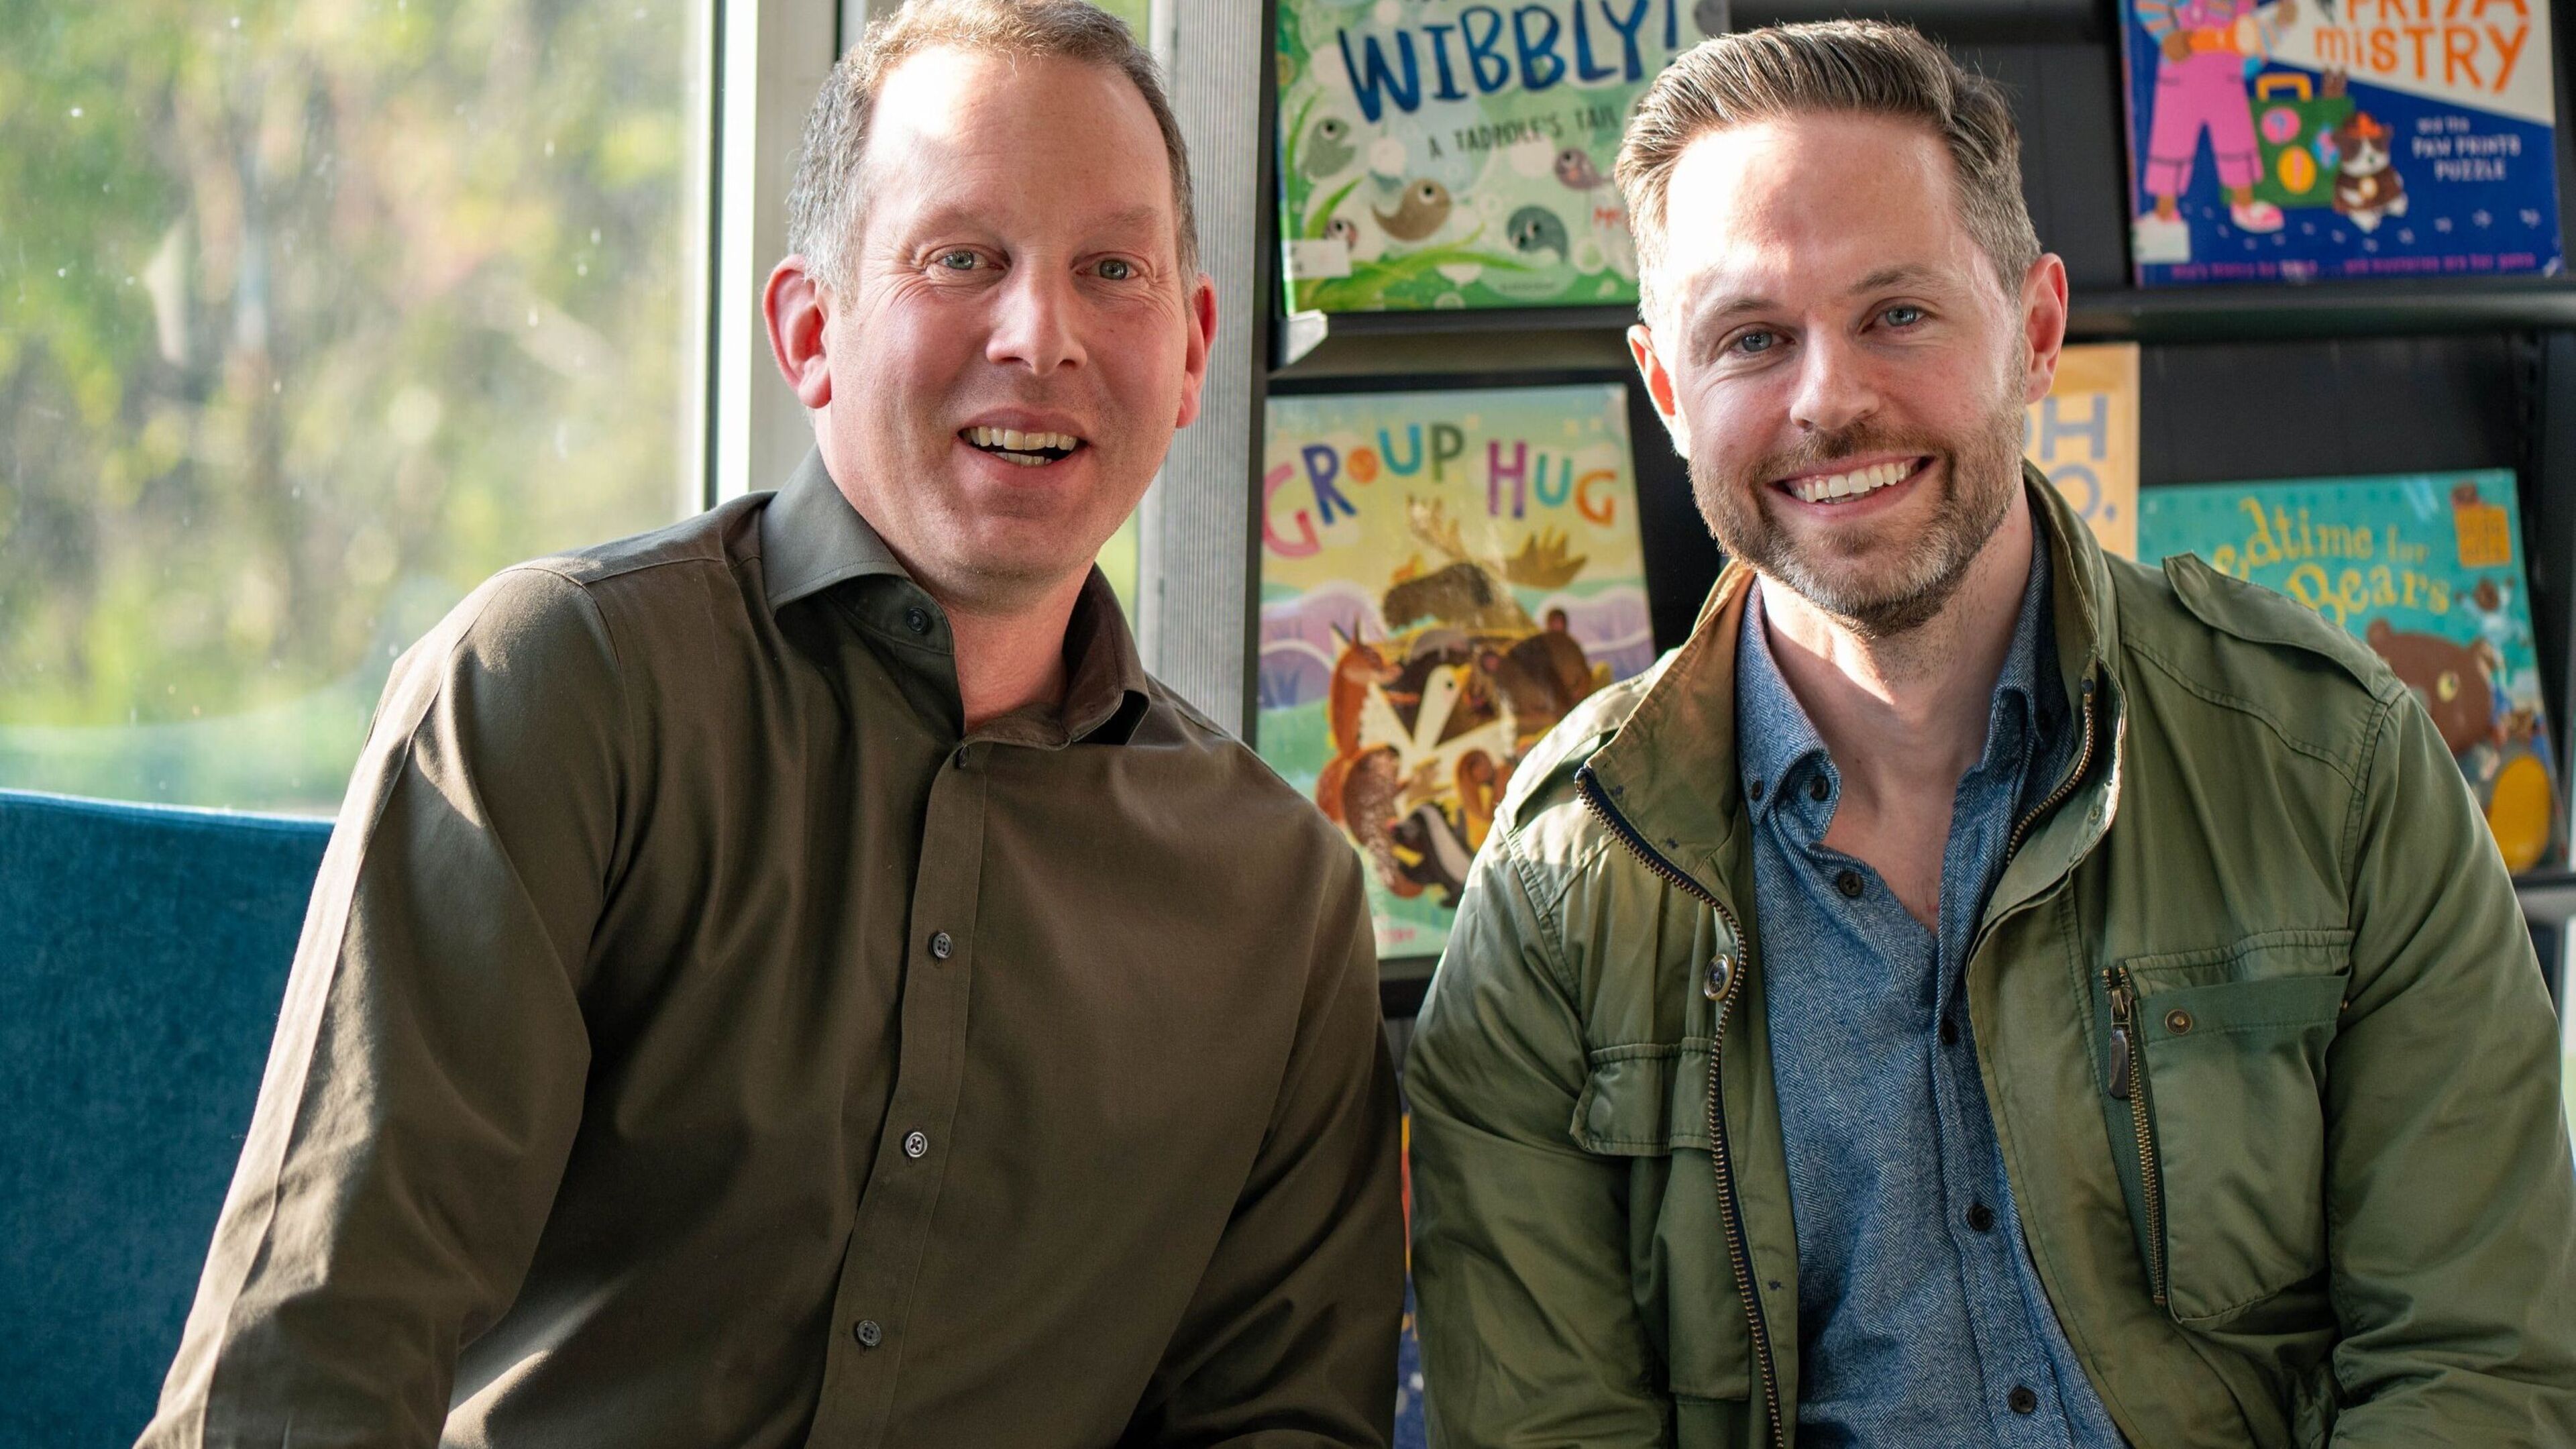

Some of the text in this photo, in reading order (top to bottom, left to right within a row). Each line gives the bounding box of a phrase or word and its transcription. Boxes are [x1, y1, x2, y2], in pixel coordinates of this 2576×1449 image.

[1338, 0, 1677, 123] WIBBLY!
[1428, 136, 1442, 158] A
[1260, 423, 1617, 559] GROUP HUG
[2213, 496, 2373, 580] edtime
